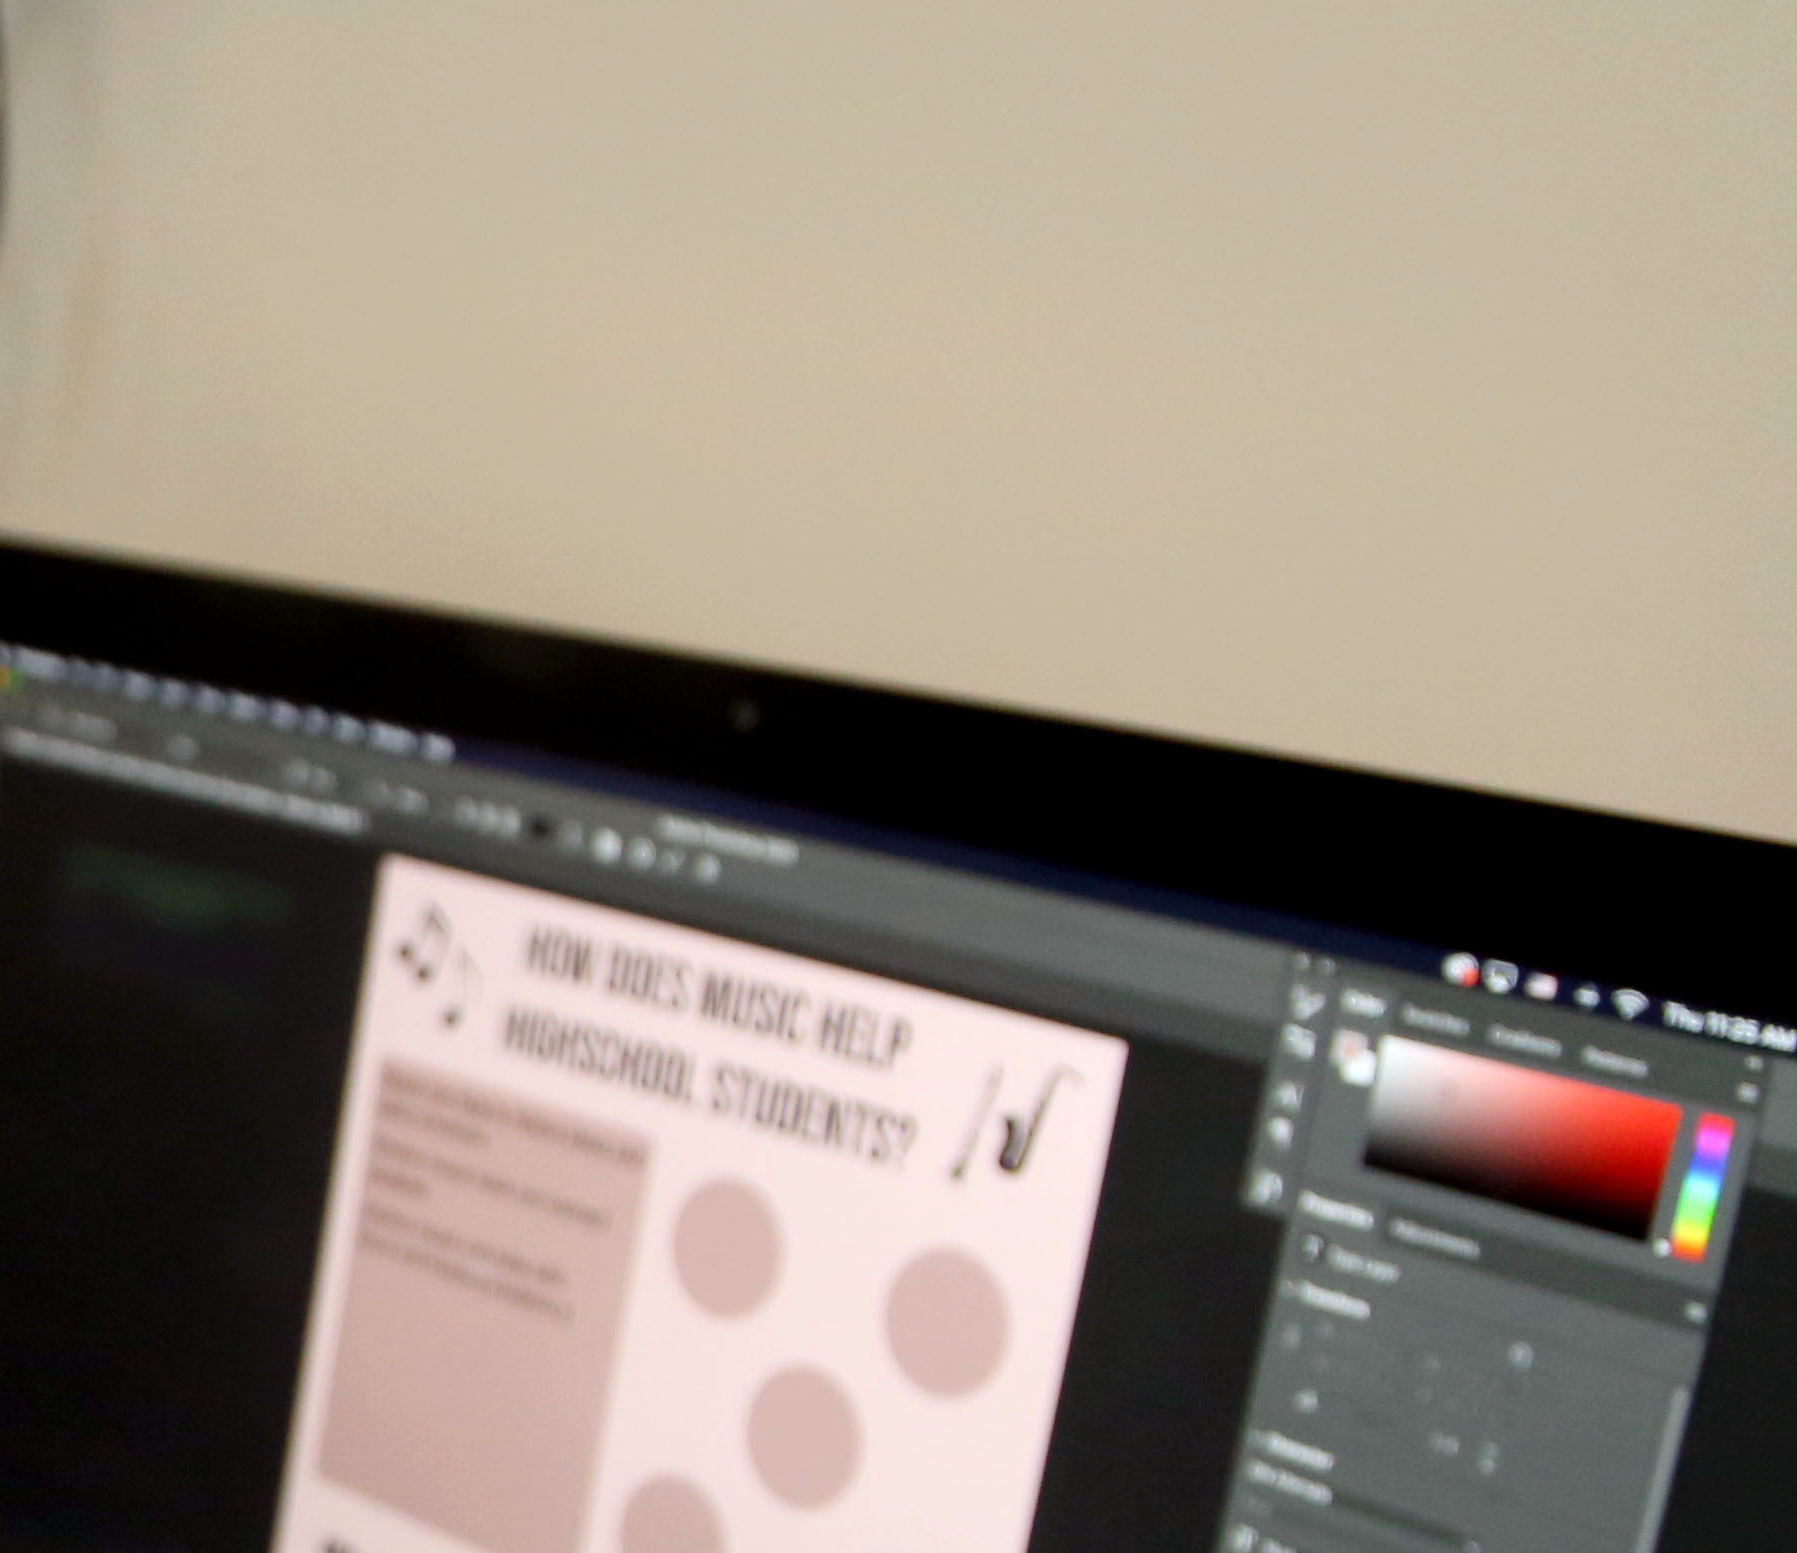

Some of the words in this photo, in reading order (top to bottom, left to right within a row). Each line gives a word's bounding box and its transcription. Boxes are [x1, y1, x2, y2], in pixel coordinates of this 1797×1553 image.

[527, 925, 595, 984] HOW
[608, 943, 693, 1011] DOES
[701, 969, 807, 1042] MUSIC
[819, 1000, 912, 1068] HELP
[505, 1007, 695, 1102] HIGHSCHOOL
[710, 1063, 919, 1160] STUDENTS?
